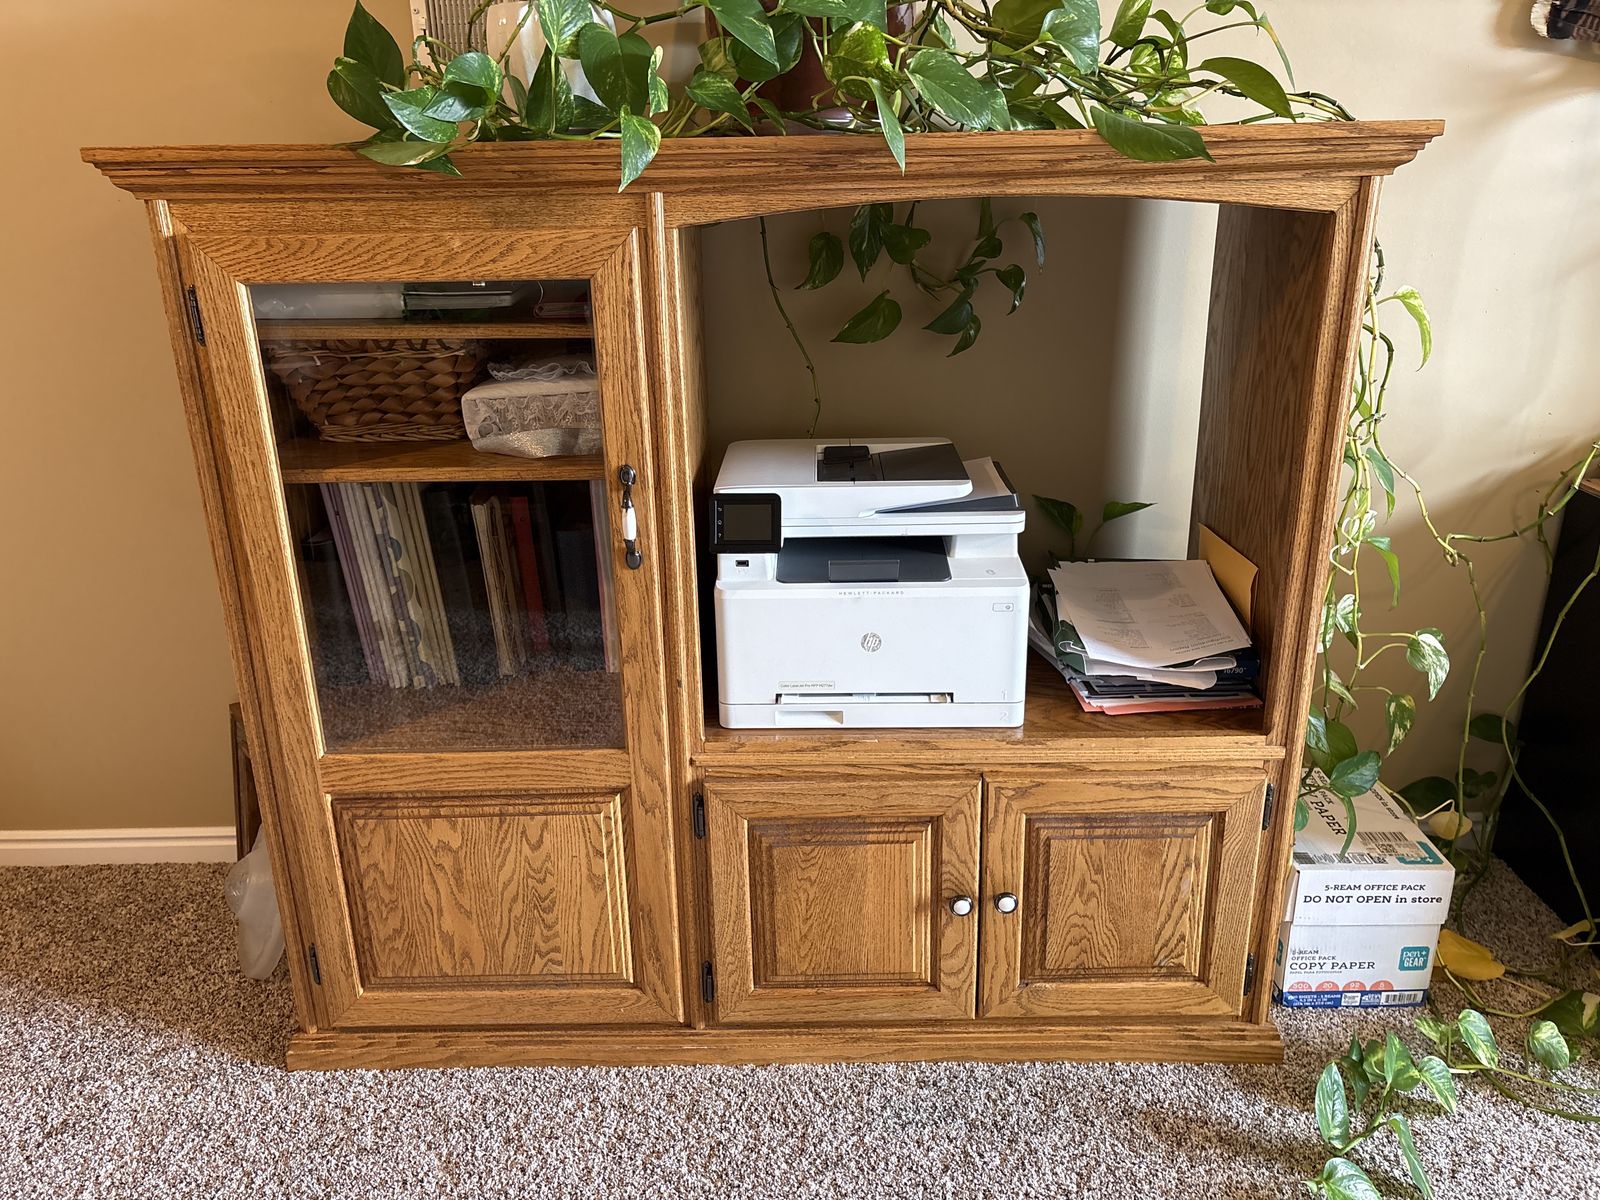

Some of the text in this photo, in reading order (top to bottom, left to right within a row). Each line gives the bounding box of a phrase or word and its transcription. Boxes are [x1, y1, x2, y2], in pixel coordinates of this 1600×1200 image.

[1310, 801, 1347, 835] PAPER
[1303, 894, 1443, 904] DO NOT OPEN in store
[1289, 961, 1376, 970] COPY PAPER
[1403, 957, 1424, 967] GEAR
